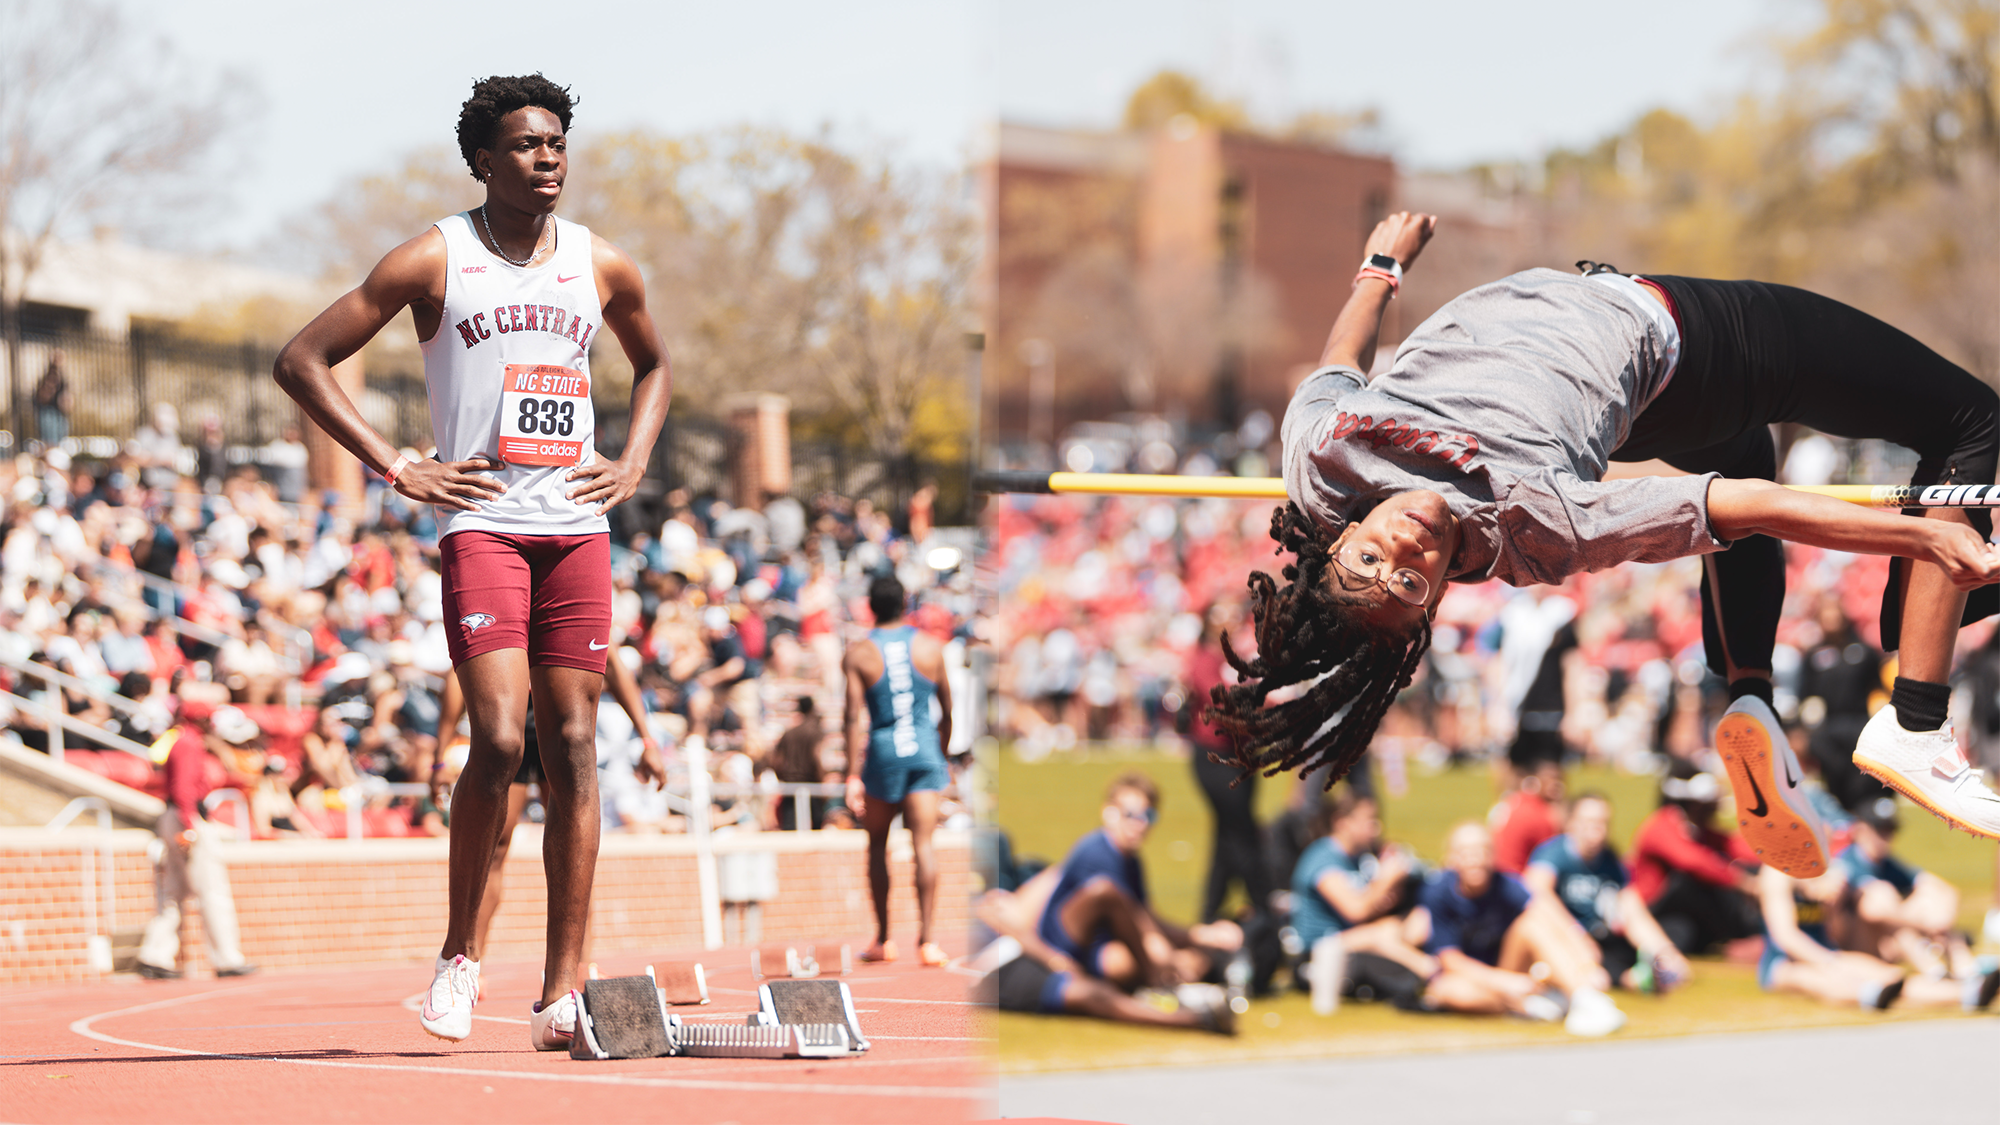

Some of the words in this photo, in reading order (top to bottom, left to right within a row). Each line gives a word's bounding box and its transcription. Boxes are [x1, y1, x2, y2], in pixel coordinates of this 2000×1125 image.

[461, 266, 487, 274] MEAC
[455, 312, 491, 349] NC
[494, 304, 593, 351] CENTRAL
[514, 373, 539, 391] NC
[540, 374, 582, 395] STATE
[518, 397, 575, 437] 833
[539, 442, 578, 457] adidas
